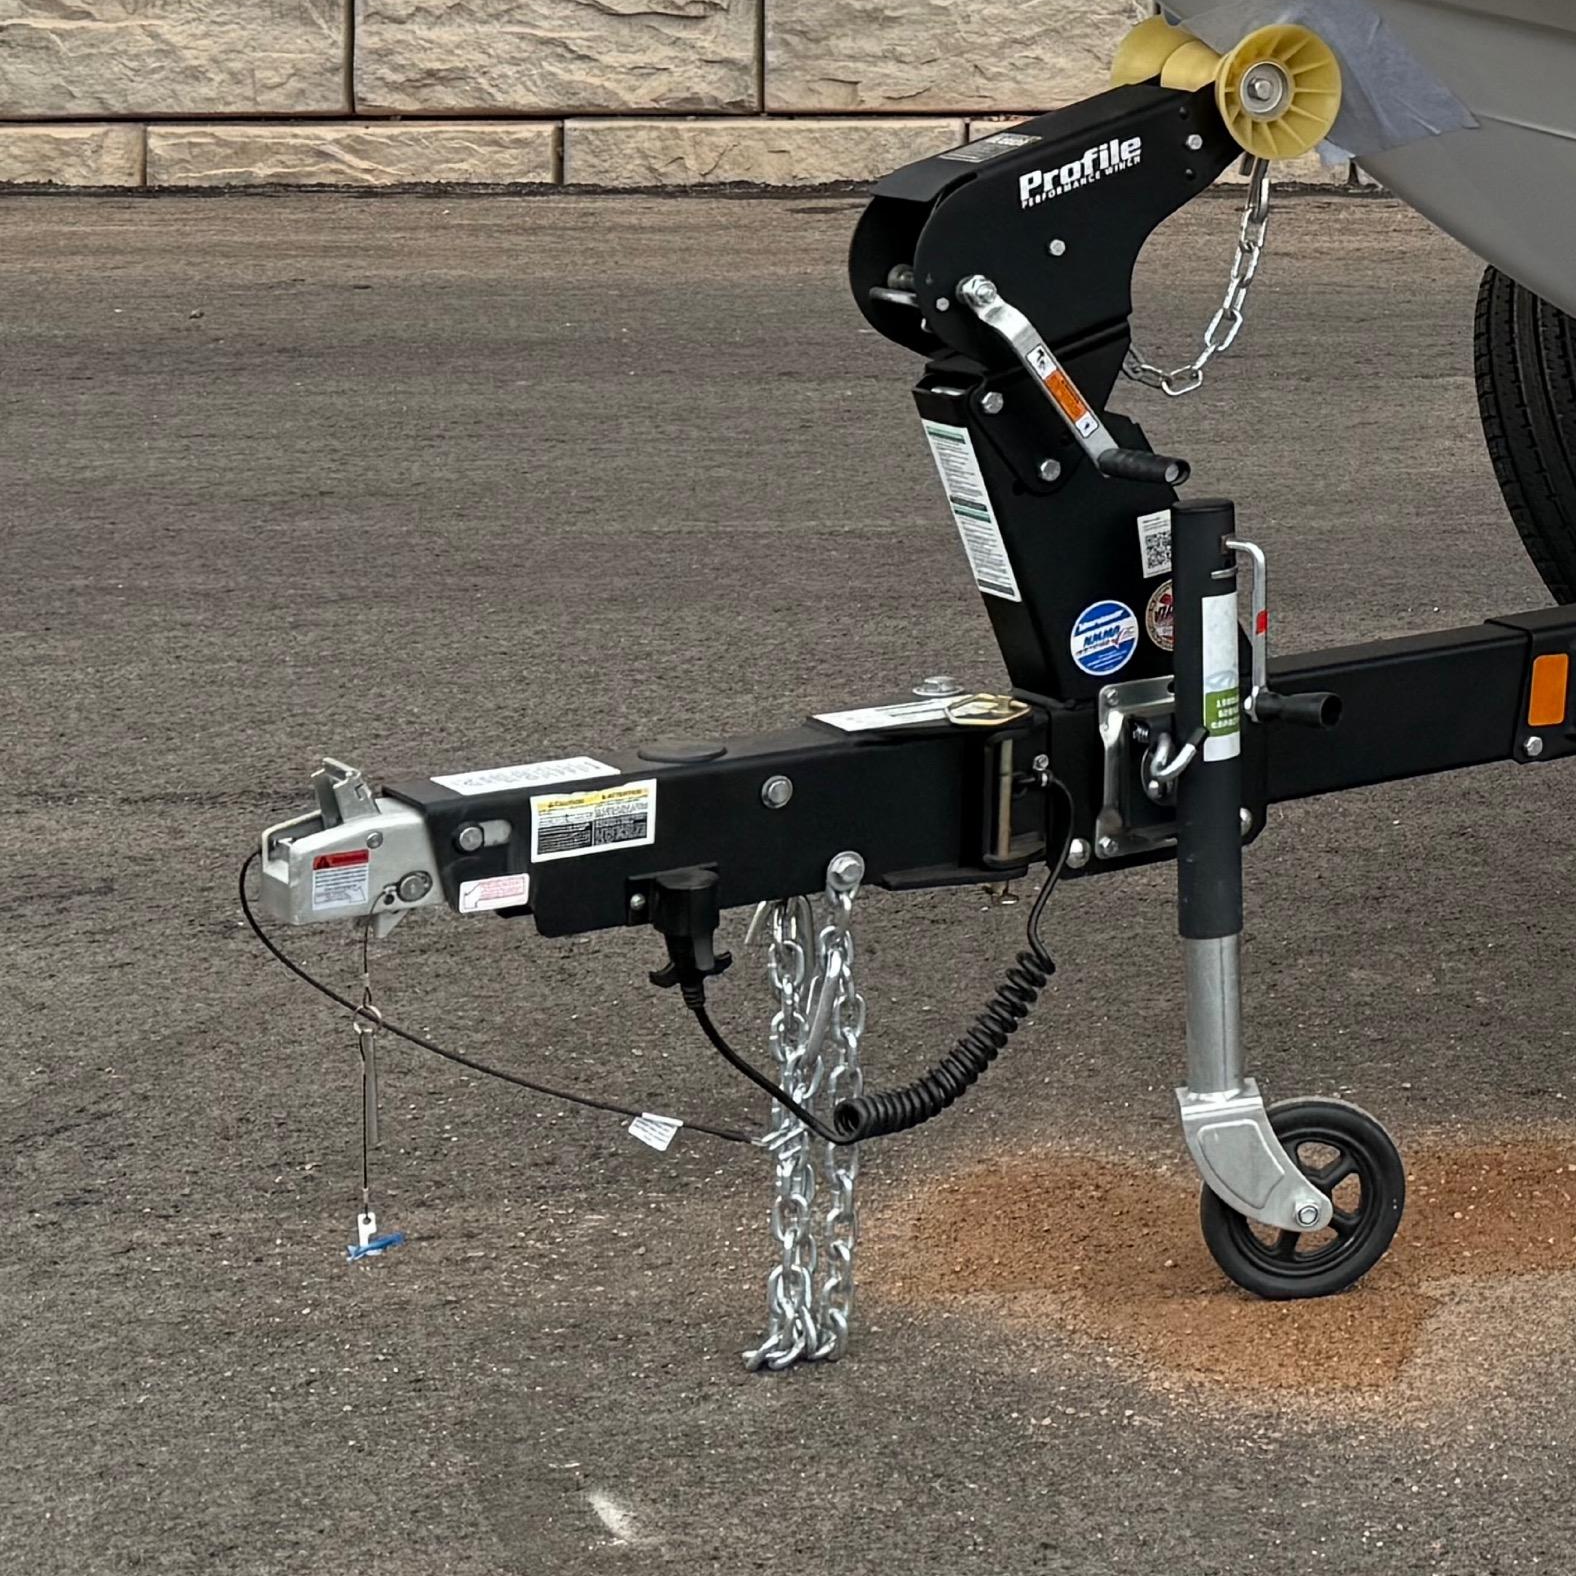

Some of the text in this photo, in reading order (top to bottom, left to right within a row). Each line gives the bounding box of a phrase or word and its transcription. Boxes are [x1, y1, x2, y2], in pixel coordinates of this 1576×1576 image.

[1019, 136, 1142, 201] Profile
[1021, 155, 1141, 209] PERFORMANCE WINCH
